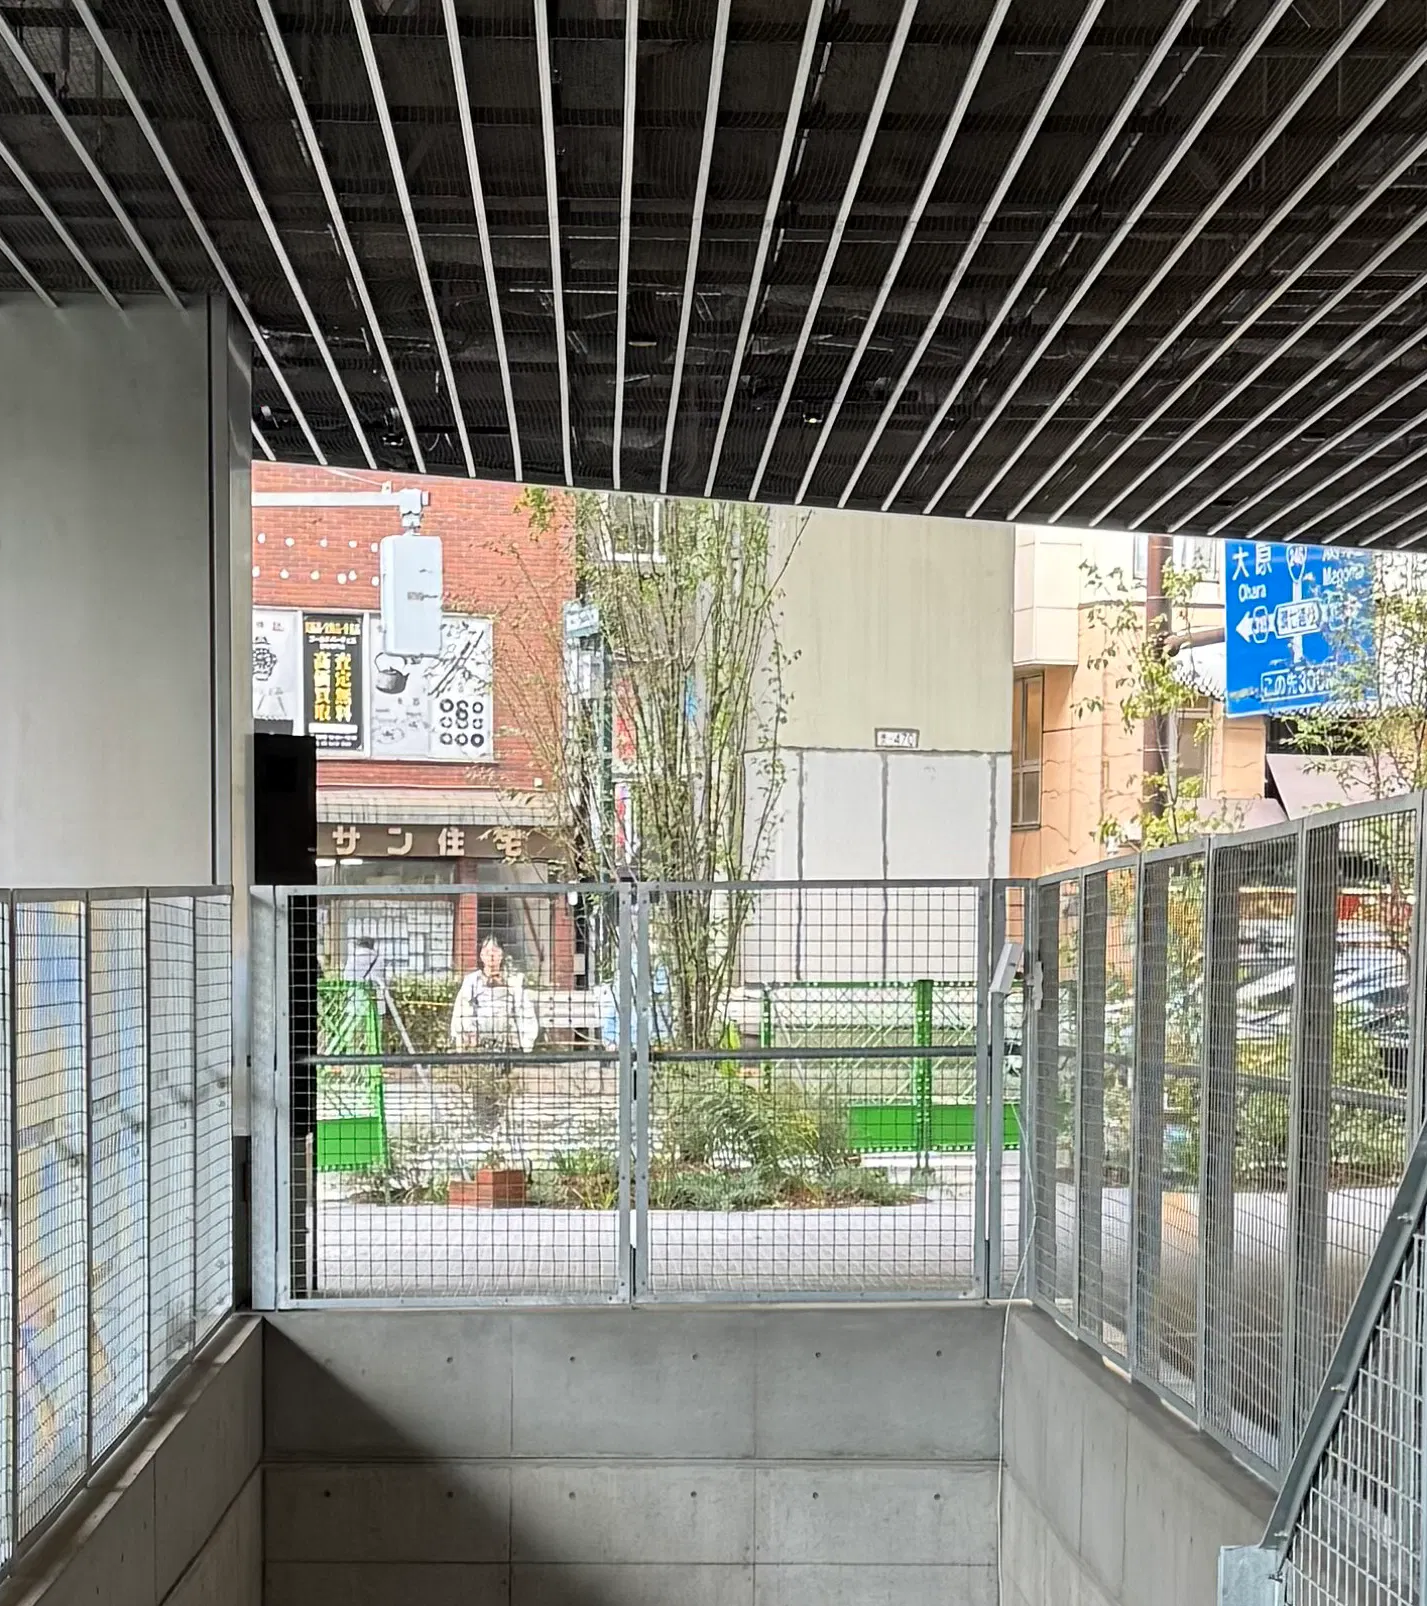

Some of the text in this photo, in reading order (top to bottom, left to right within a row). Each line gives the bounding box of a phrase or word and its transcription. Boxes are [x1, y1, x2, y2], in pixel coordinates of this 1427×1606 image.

[1231, 543, 1272, 581] 大原
[332, 825, 522, 857] サン住宅
